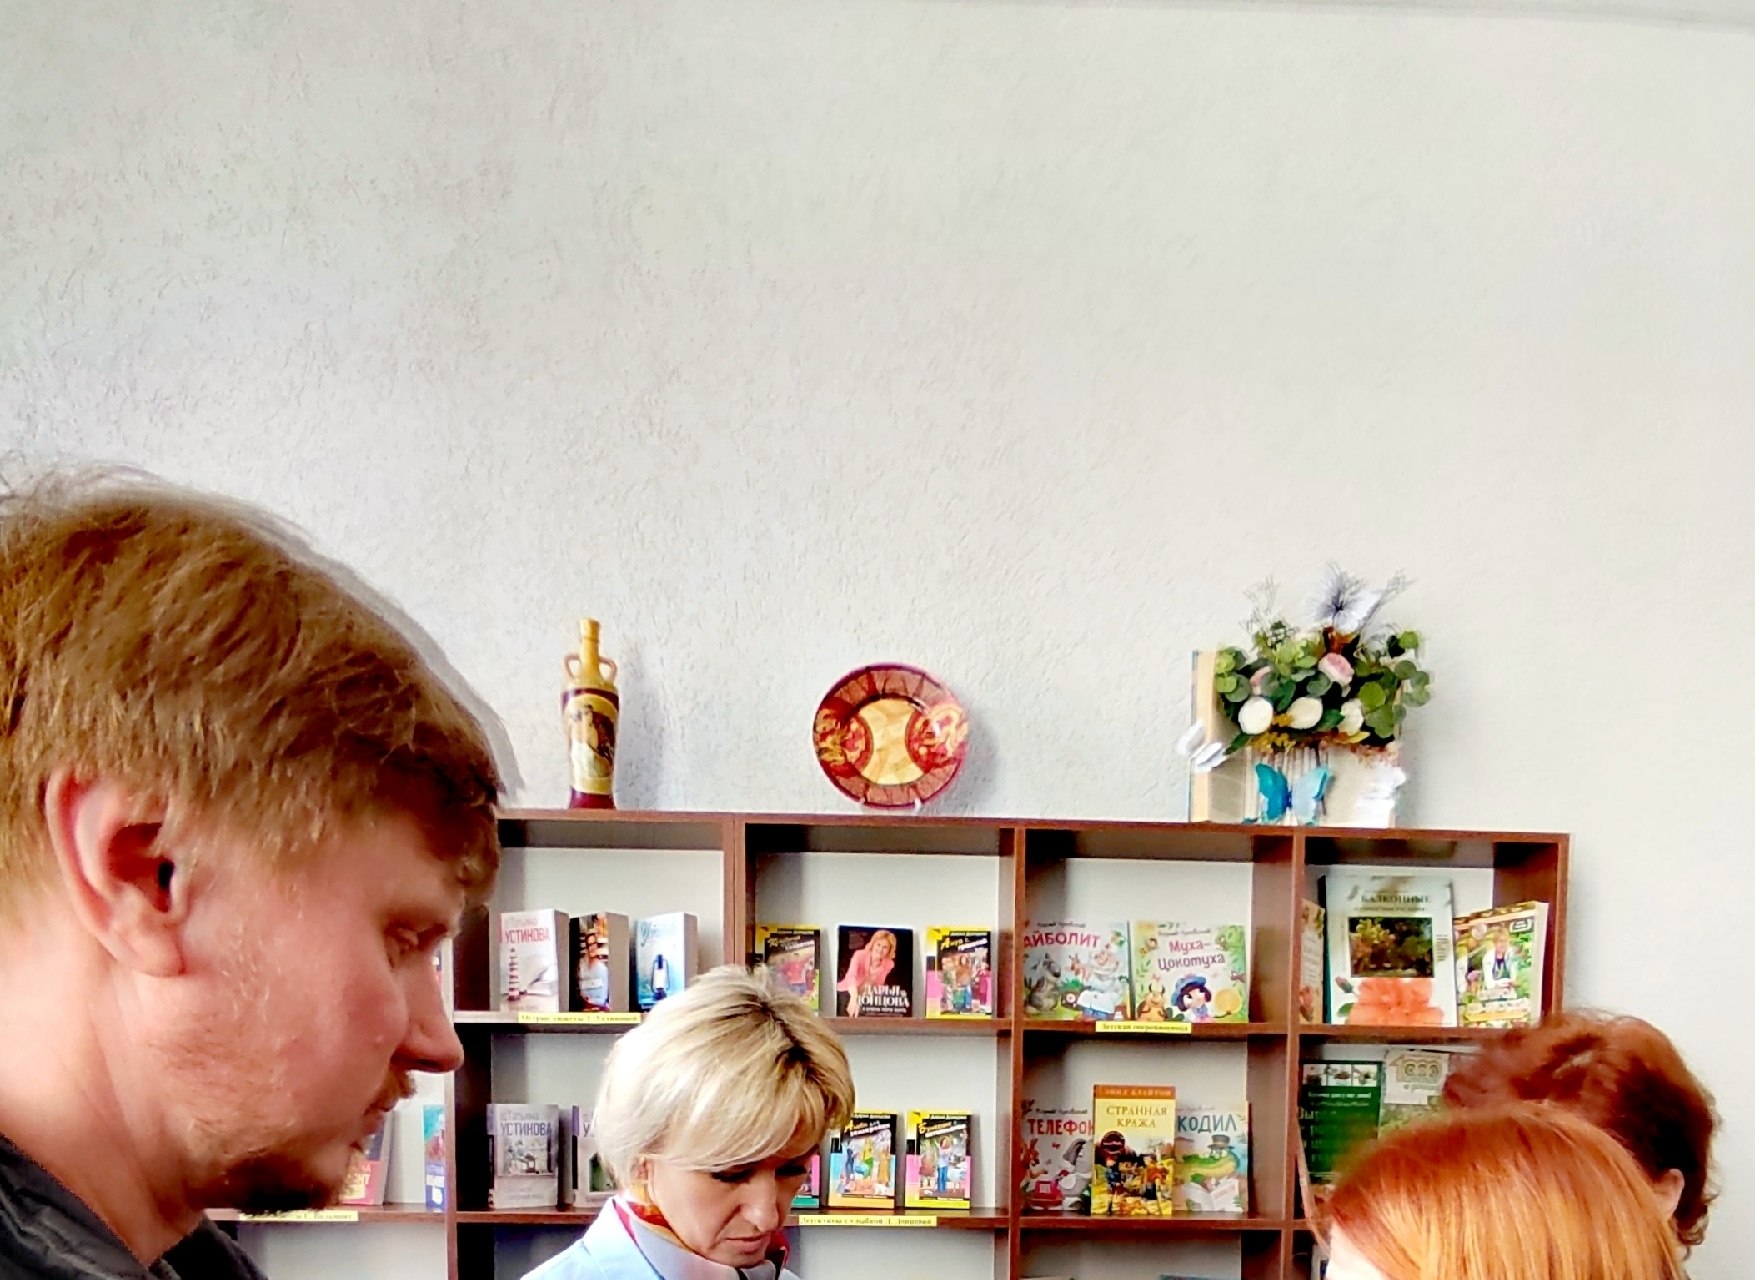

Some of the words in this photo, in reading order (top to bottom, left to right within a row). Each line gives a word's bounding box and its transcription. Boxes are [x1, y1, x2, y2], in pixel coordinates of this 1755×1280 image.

[504, 927, 551, 944] УСТИНОВА
[1023, 930, 1100, 949] АЙБОЛИТ
[1169, 940, 1212, 955] Муха-
[1157, 953, 1226, 972] Цокотуха
[1105, 1105, 1168, 1117] СТРАННАЯ
[500, 1122, 552, 1137] УСТИНОВА
[1116, 1118, 1157, 1129] КРАЖА
[1177, 1113, 1237, 1134] КОДИЛ
